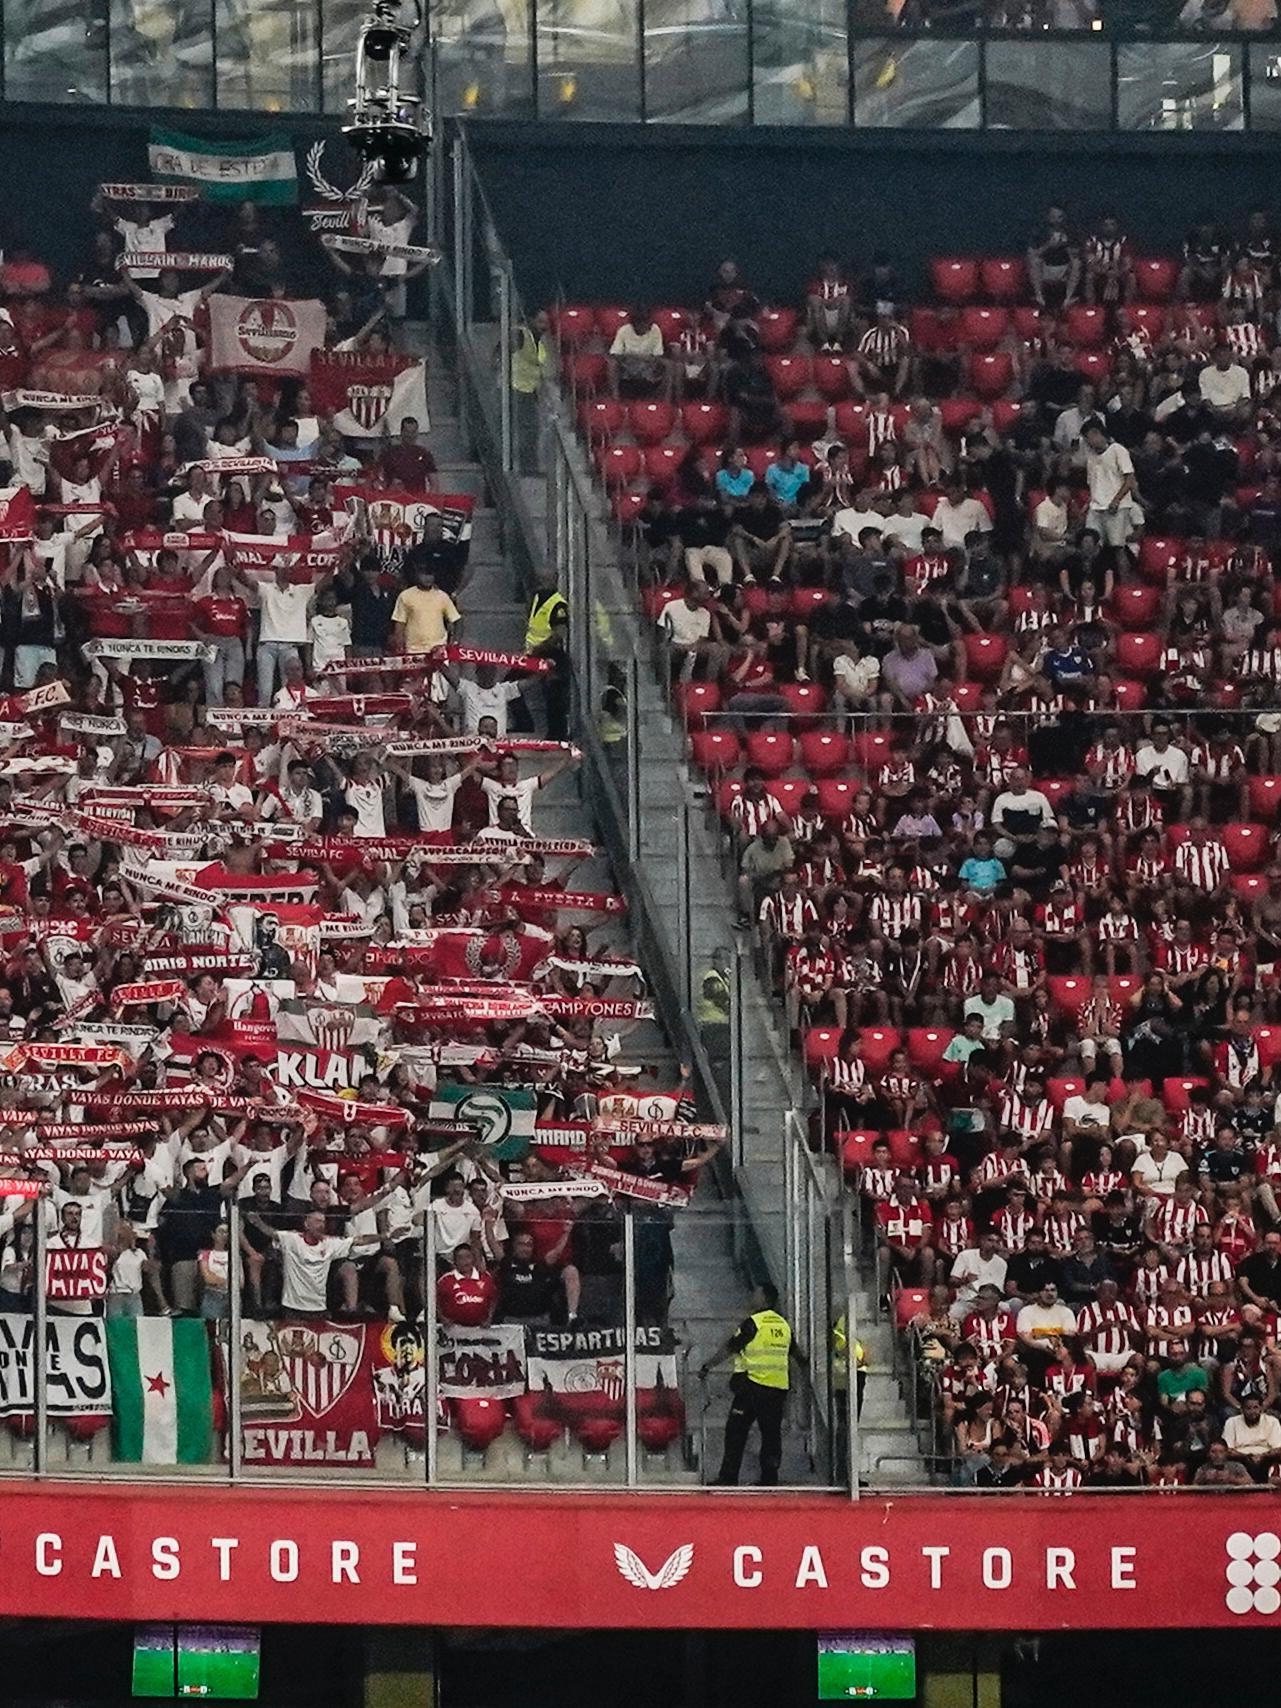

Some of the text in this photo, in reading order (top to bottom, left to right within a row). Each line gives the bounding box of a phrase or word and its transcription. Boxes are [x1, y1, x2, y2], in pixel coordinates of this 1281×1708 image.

[458, 647, 528, 667] SEVILLA FC
[33, 685, 59, 704] F.C.
[212, 711, 245, 722] NUNCA
[392, 739, 429, 751] NUNCA
[449, 737, 482, 749] RINDO
[124, 867, 165, 890] NUNCA
[165, 880, 182, 893] ME
[183, 885, 218, 904] RINDO
[191, 952, 252, 969] NORTE
[233, 1018, 276, 1033] Hangove
[71, 1093, 111, 1106] VAYAS
[114, 1095, 161, 1107] DONDE
[164, 1094, 204, 1106] VAYAS
[1, 1110, 35, 1122] VAYA
[44, 1125, 80, 1138] VAYAS
[619, 1121, 674, 1137] SEVILLA
[56, 1148, 106, 1159] DONDE
[505, 1187, 545, 1197] NUNCA
[37, 1533, 416, 1583] CASTORE
[734, 1546, 1135, 1588] CASTORE
